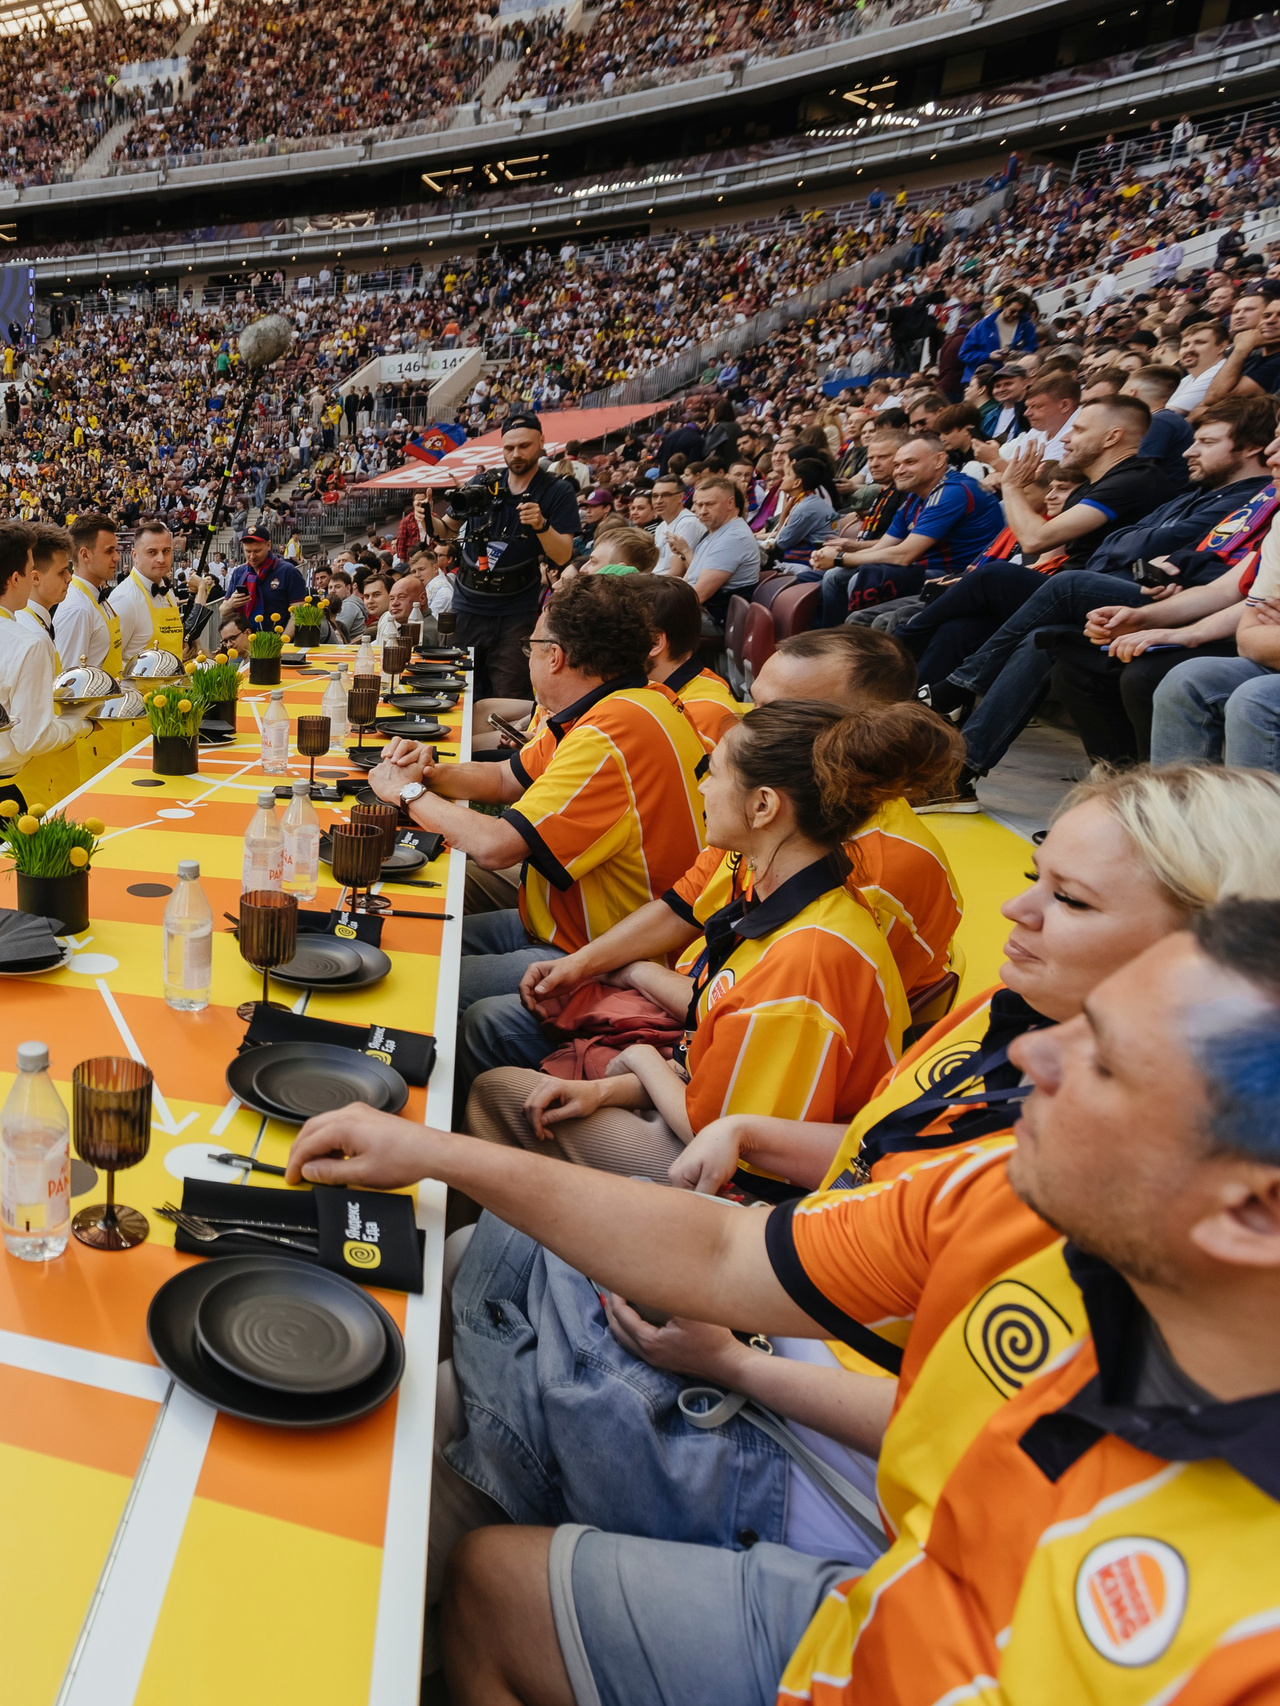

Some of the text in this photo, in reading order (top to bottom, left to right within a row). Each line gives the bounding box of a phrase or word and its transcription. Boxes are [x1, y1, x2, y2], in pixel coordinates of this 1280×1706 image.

[397, 360, 421, 374] 146
[381, 1039, 397, 1053] Еда
[344, 1200, 362, 1240] Яндекс
[362, 1221, 381, 1243] Еда
[1095, 1564, 1138, 1641] KING
